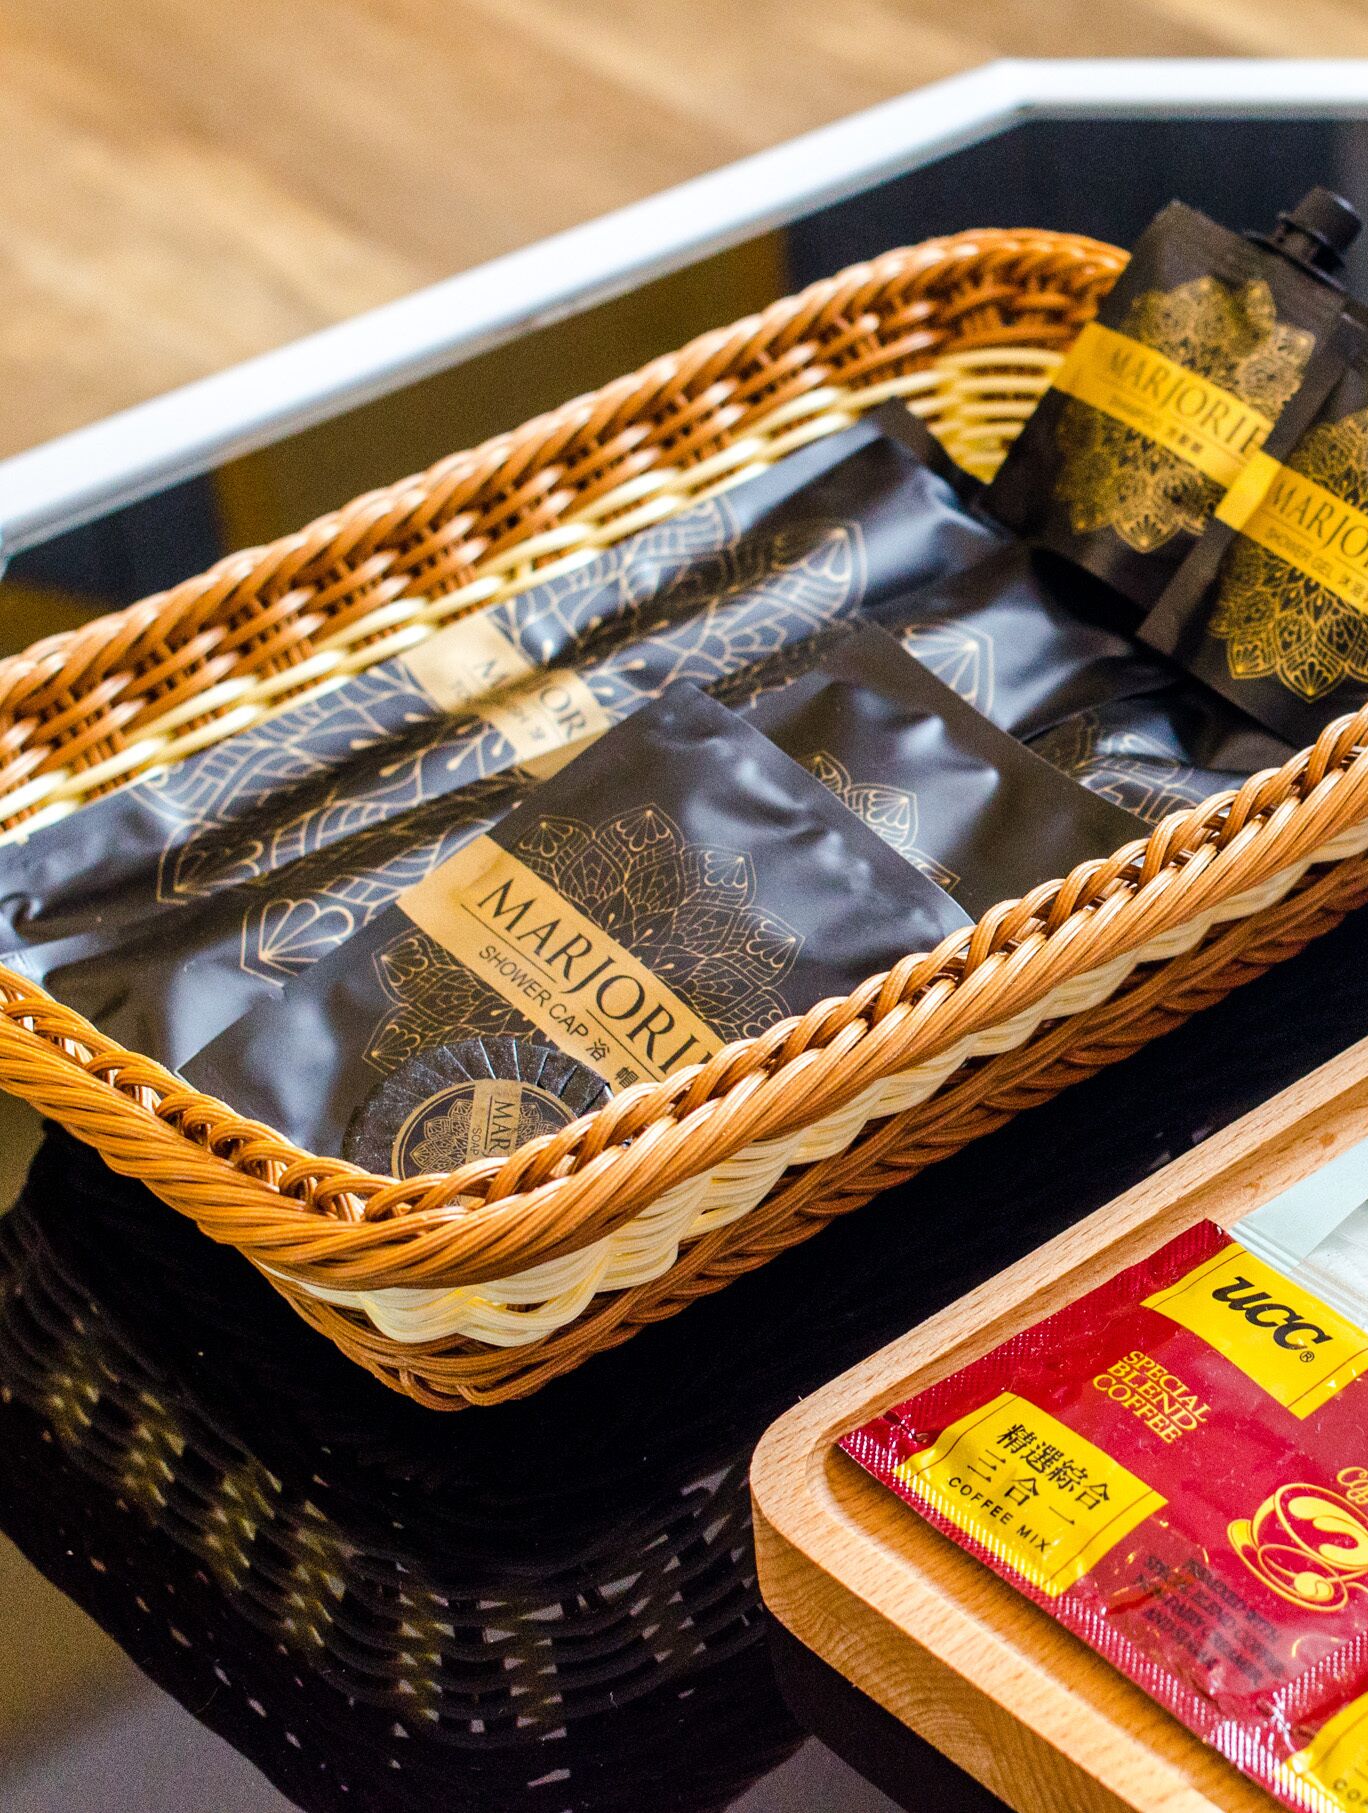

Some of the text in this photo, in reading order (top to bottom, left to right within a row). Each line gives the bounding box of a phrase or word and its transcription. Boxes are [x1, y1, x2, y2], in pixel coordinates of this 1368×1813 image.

[477, 877, 714, 1075] MARJORI
[479, 945, 590, 1040] SHOWER CAP
[470, 1126, 483, 1156] SOAP
[1092, 1374, 1183, 1444] COFFEE
[1107, 1360, 1198, 1431] BLEND
[1122, 1350, 1212, 1423] SPECIAL
[996, 1423, 1111, 1511] 精選綜合
[948, 1476, 1052, 1553] COFFEE MIX
